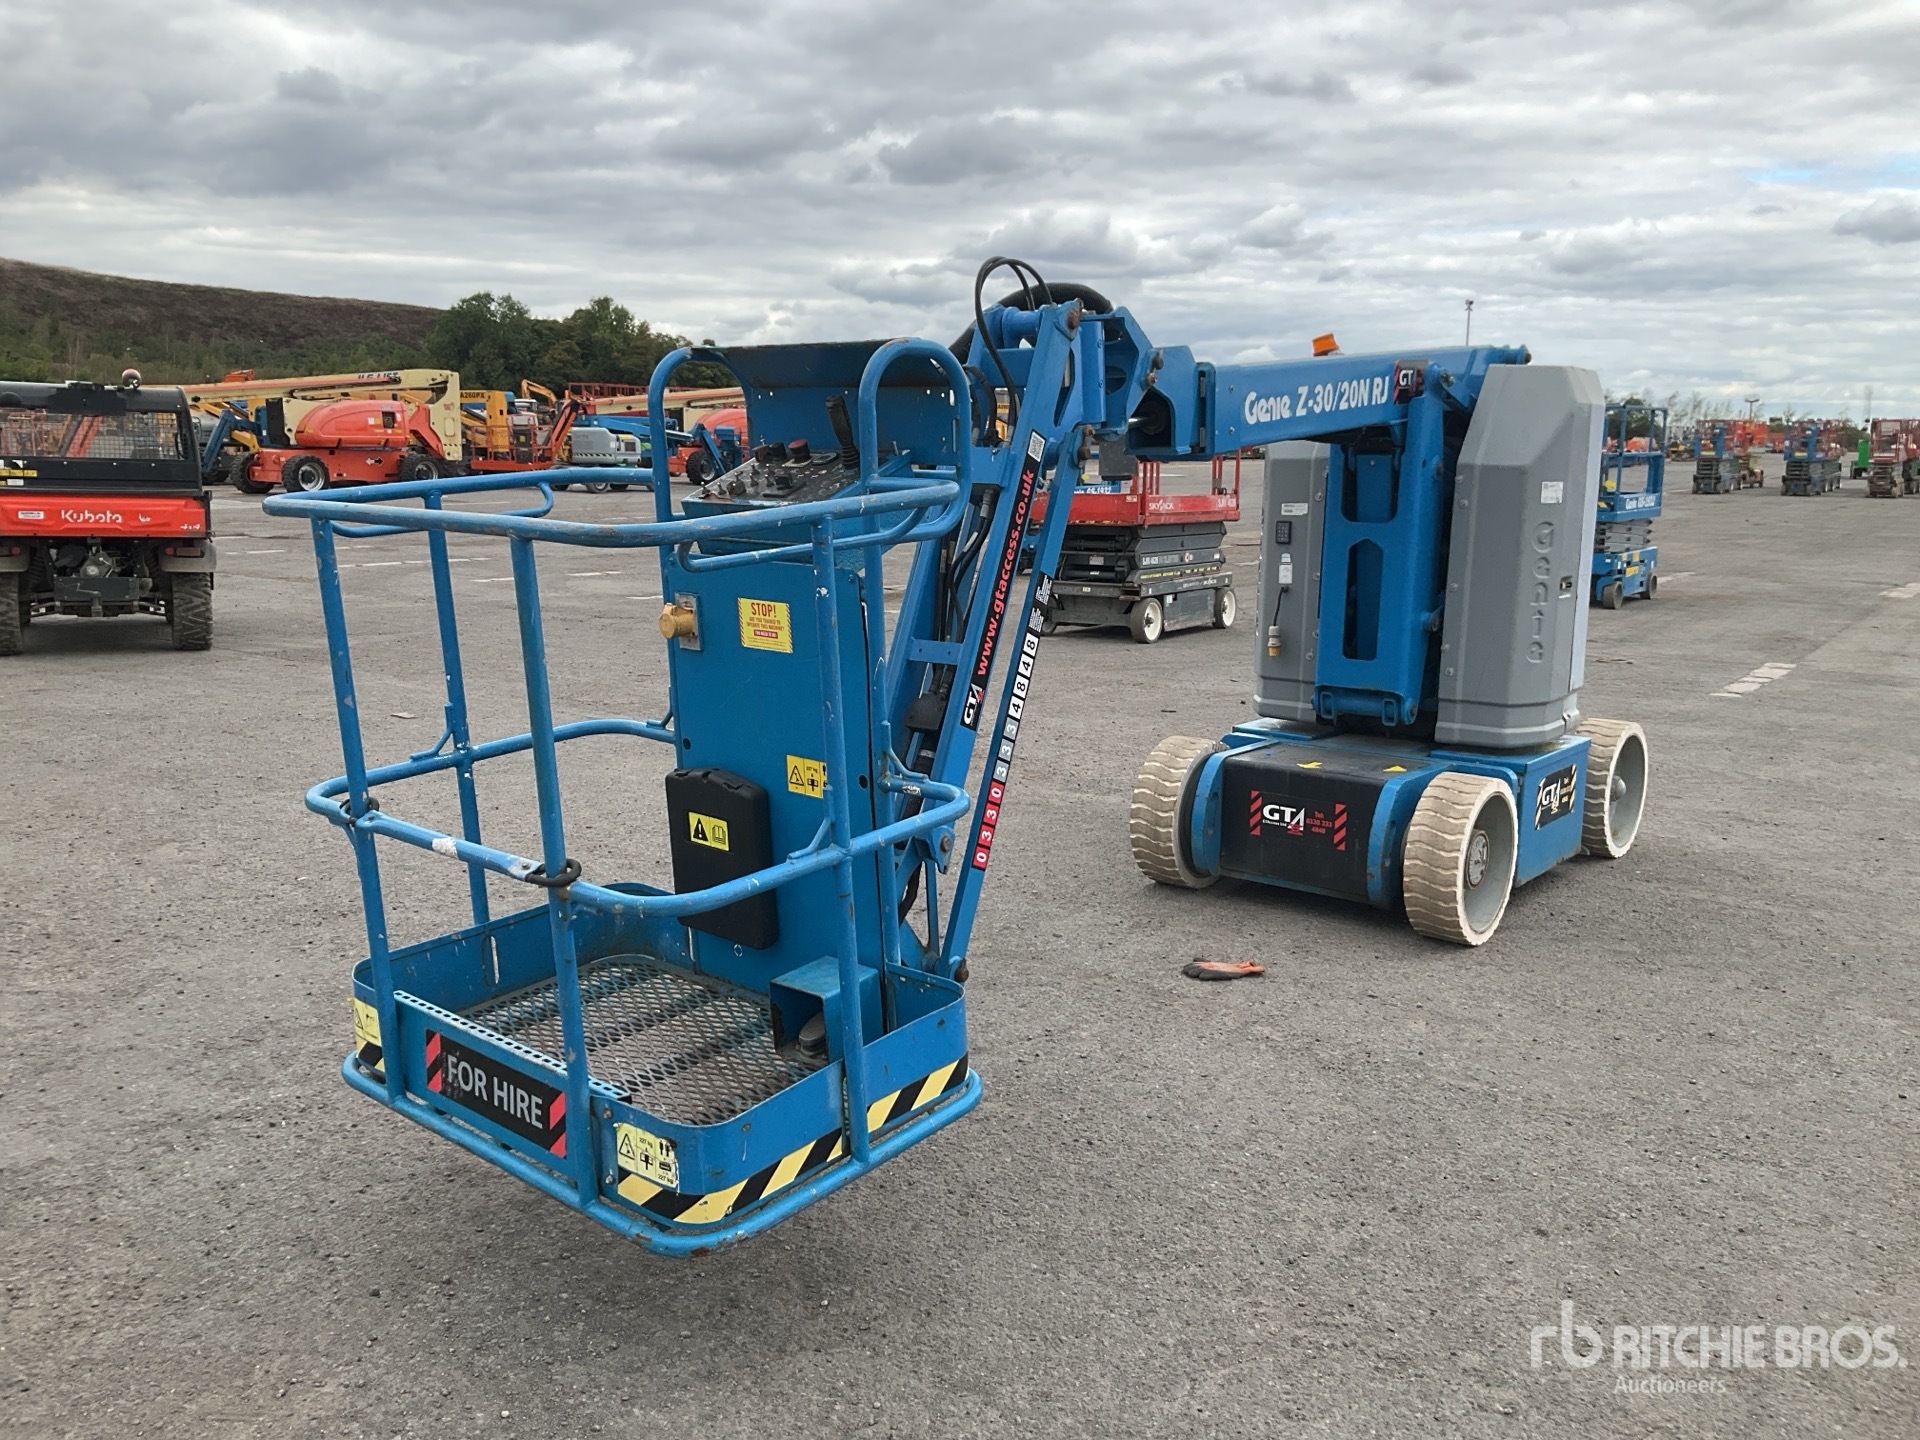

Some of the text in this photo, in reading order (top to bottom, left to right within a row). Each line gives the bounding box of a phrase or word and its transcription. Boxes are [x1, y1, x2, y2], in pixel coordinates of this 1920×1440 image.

[1245, 375, 1390, 424] Genie Z-30/20N RJ
[61, 509, 122, 523] Kubota
[977, 468, 1035, 676] www.gtaccess.co.uk
[750, 602, 777, 618] STOP!
[975, 638, 1036, 863] 0330 333 4848
[447, 1054, 543, 1129] FOR HIRE
